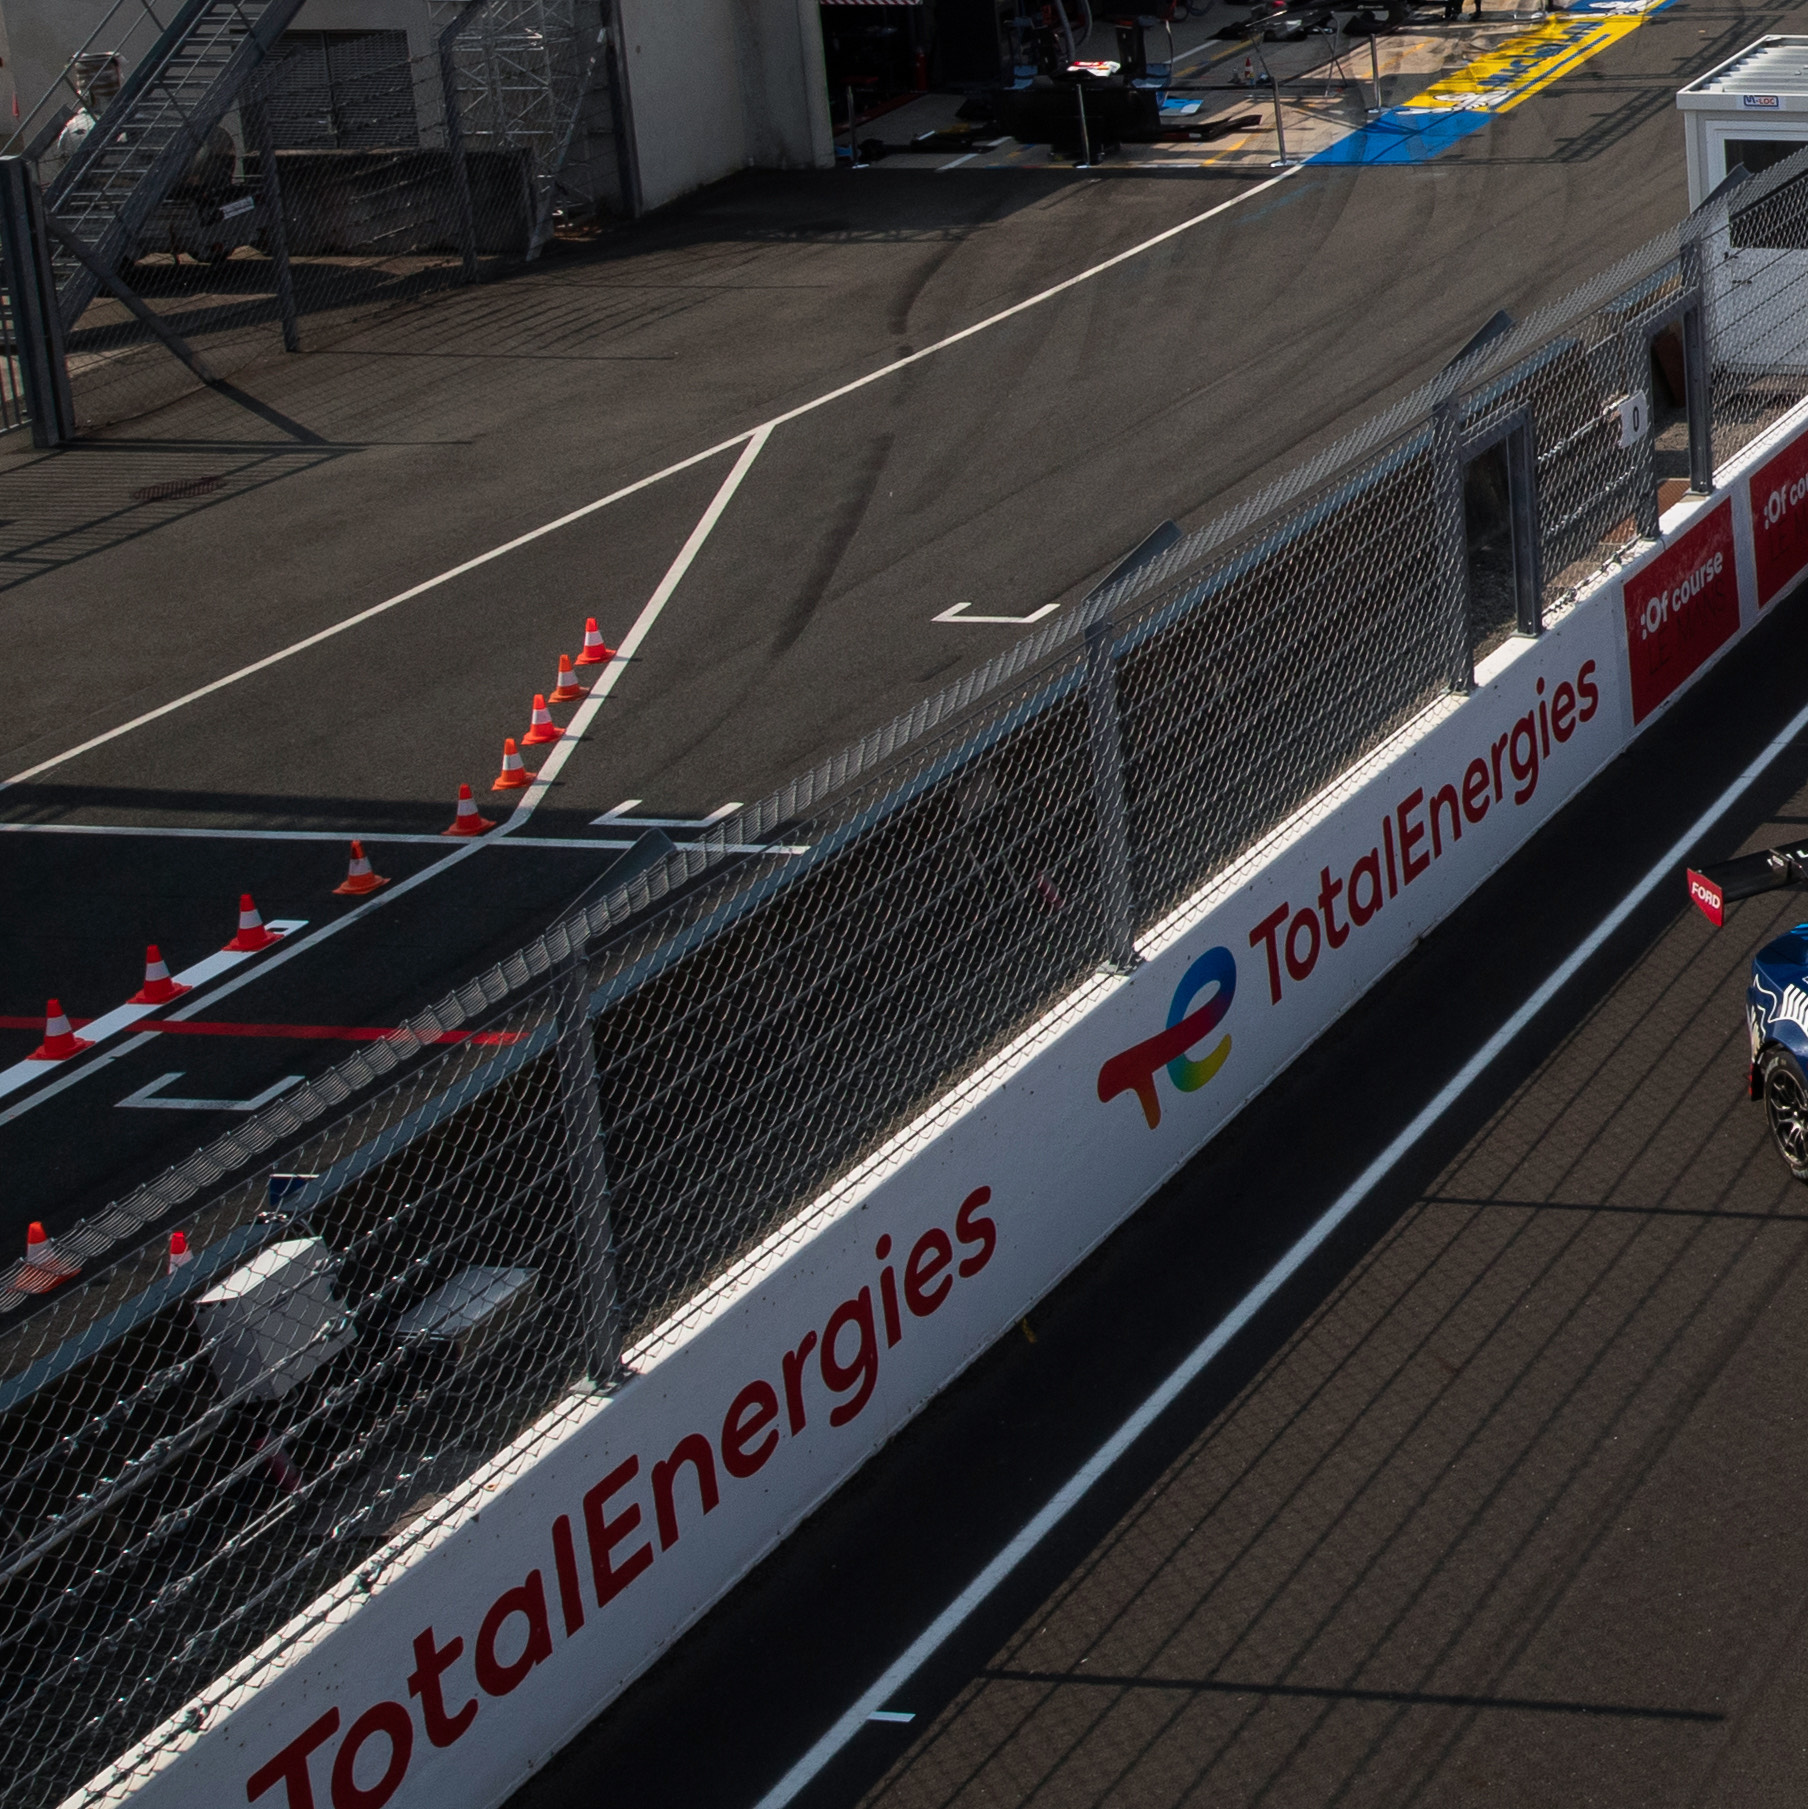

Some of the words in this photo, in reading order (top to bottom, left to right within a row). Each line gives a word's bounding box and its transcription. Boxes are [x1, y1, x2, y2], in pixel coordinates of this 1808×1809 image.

[1672, 551, 1724, 612] course
[1248, 655, 1601, 1007] TotalEnergies
[1691, 882, 1721, 910] FORD
[246, 1185, 997, 1808] TotalEnergies
